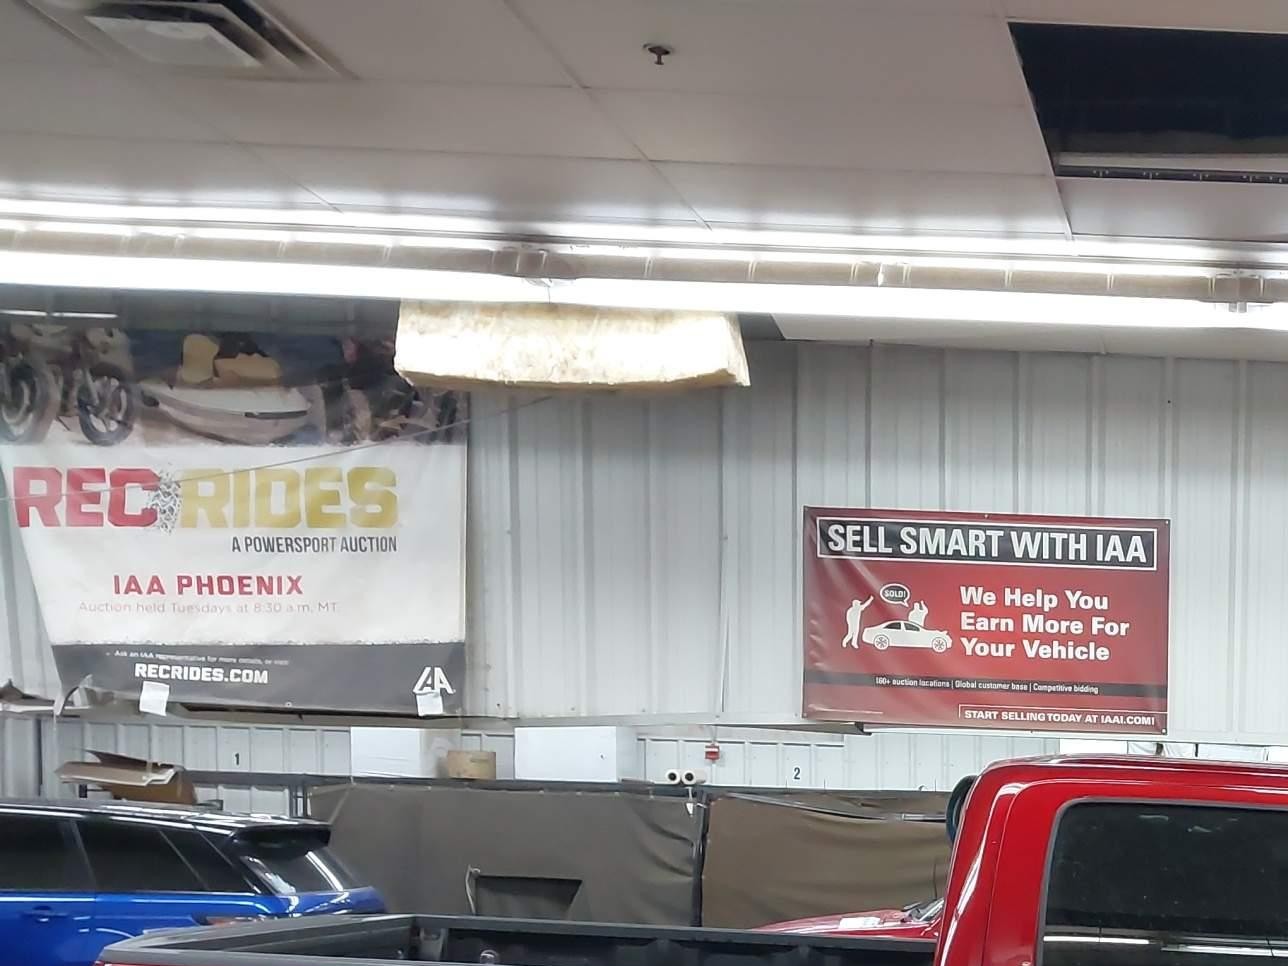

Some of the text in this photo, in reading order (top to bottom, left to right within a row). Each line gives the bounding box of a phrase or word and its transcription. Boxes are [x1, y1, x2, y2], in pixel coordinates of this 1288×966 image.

[13, 466, 398, 528] REC RIDES
[232, 536, 397, 553] A POWERSPORT AUCTION
[827, 524, 1147, 563] SELL SMART WITH IAA
[113, 575, 303, 595] IAA PHOENIX
[80, 602, 131, 612] Auction
[136, 602, 165, 612] held
[172, 602, 231, 616] Tuesdays
[237, 603, 248, 613] at
[960, 586, 1109, 612] We Help You
[960, 612, 1129, 636] Earn More For
[960, 637, 1111, 661] Your Vehicle
[135, 663, 268, 684] RECRIDES.COM
[892, 678, 917, 687] auction
[919, 679, 950, 688] locations
[955, 680, 977, 688] Global
[978, 681, 1010, 689] customer
[1011, 682, 1028, 691] base
[1033, 683, 1072, 693] Competitive
[1073, 684, 1099, 694] bidding
[964, 710, 998, 720] START
[1001, 711, 1046, 721] SELLING
[1047, 713, 1082, 722] TODAY
[1085, 714, 1098, 723] AT
[235, 752, 240, 766] 1
[794, 767, 801, 780] 2
